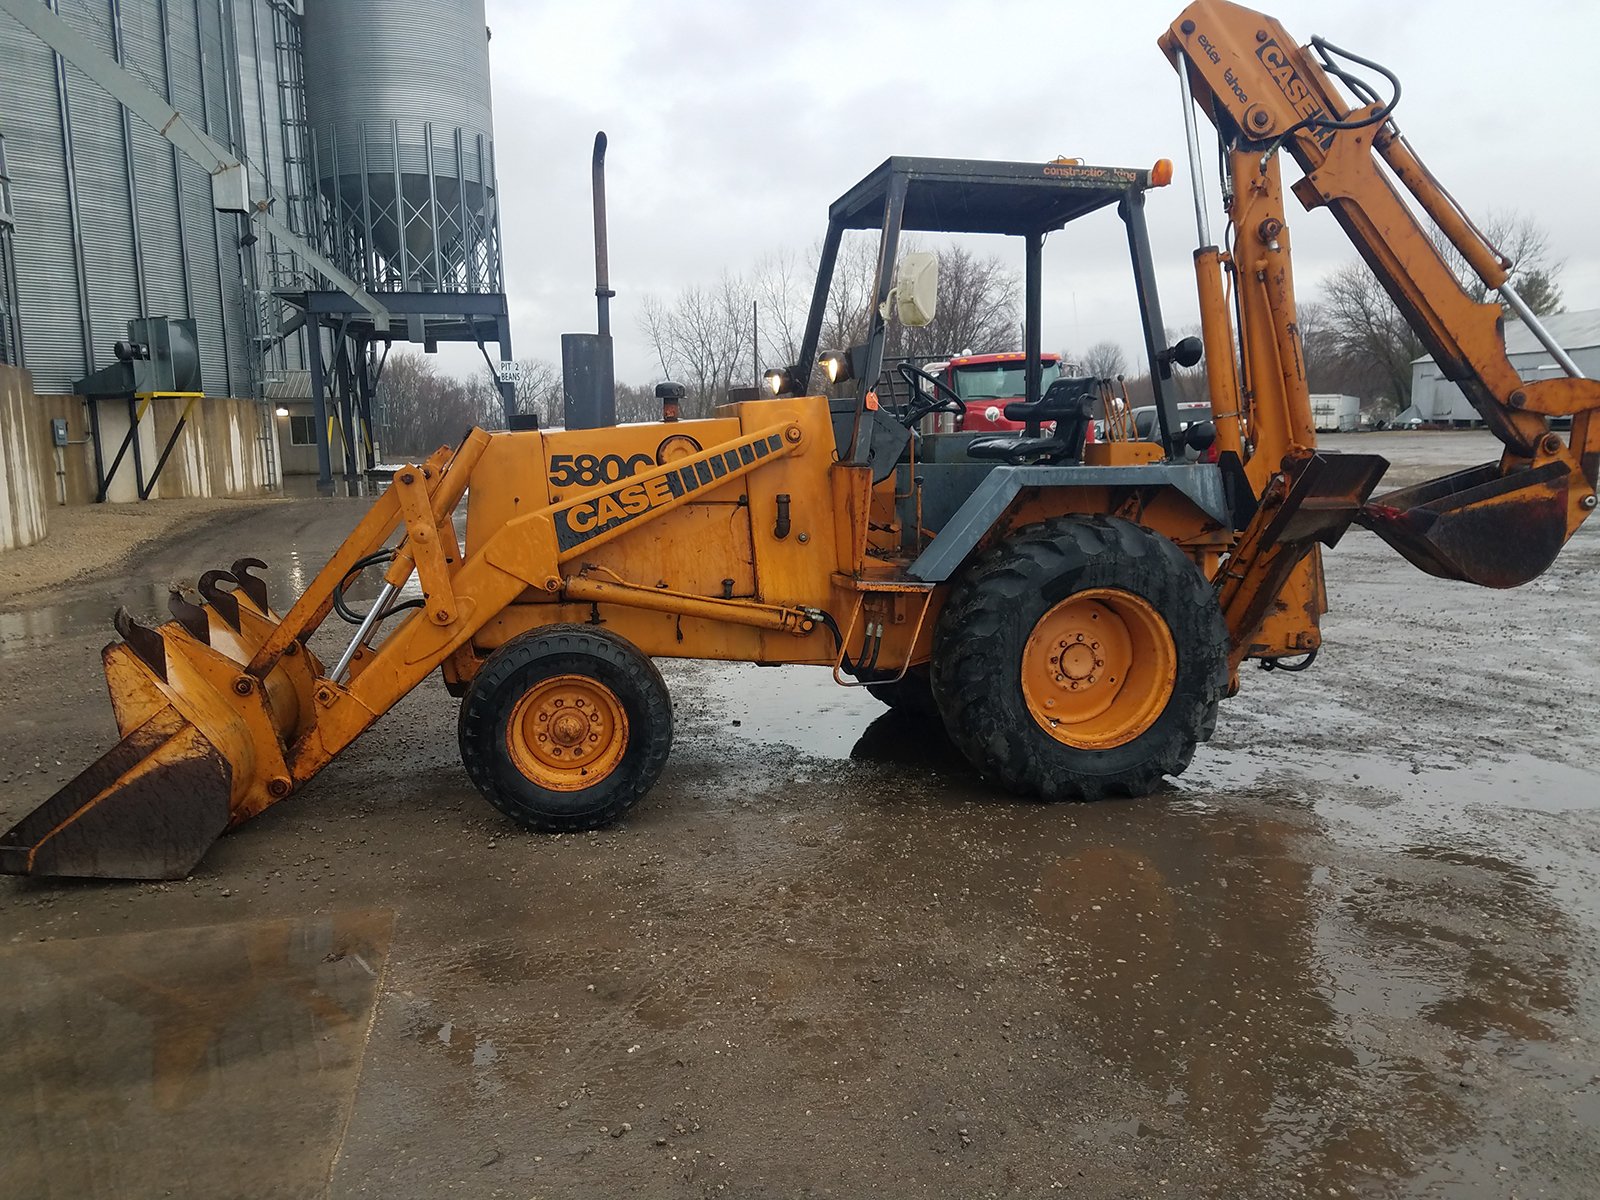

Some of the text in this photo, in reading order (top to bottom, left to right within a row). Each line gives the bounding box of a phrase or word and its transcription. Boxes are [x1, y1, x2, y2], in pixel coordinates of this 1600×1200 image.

[1261, 45, 1320, 120] CASE
[1043, 166, 1110, 179] constructio
[501, 362, 520, 371] PIT 2
[501, 372, 521, 381] BEANS
[566, 474, 675, 534] CASE
